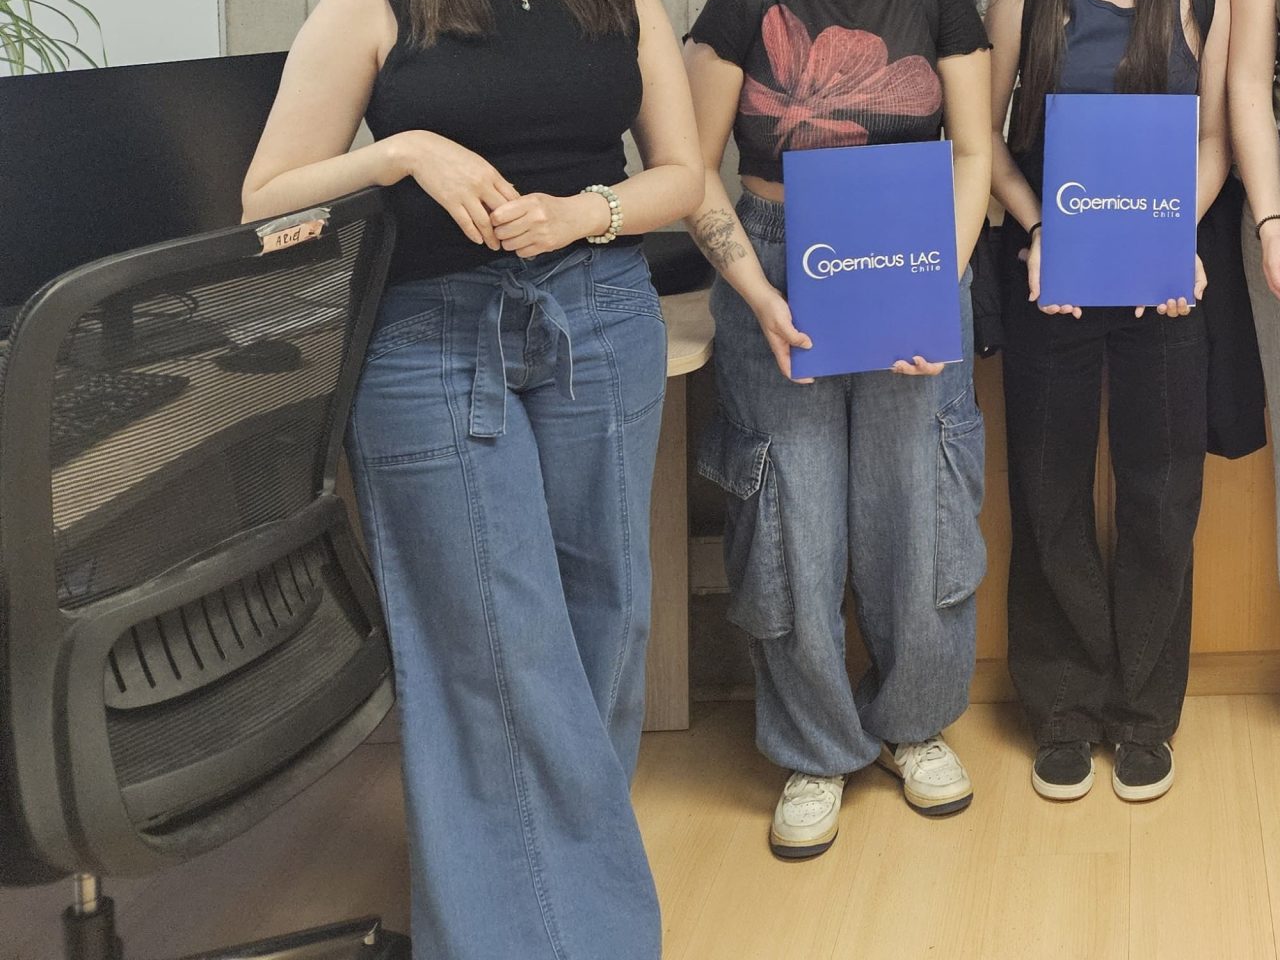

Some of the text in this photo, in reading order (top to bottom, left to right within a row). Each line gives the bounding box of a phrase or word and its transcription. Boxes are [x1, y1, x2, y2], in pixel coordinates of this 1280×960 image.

[1056, 181, 1181, 215] Copernicus LAC
[802, 243, 941, 280] Copernicus LAC
[911, 265, 942, 273] Chile
